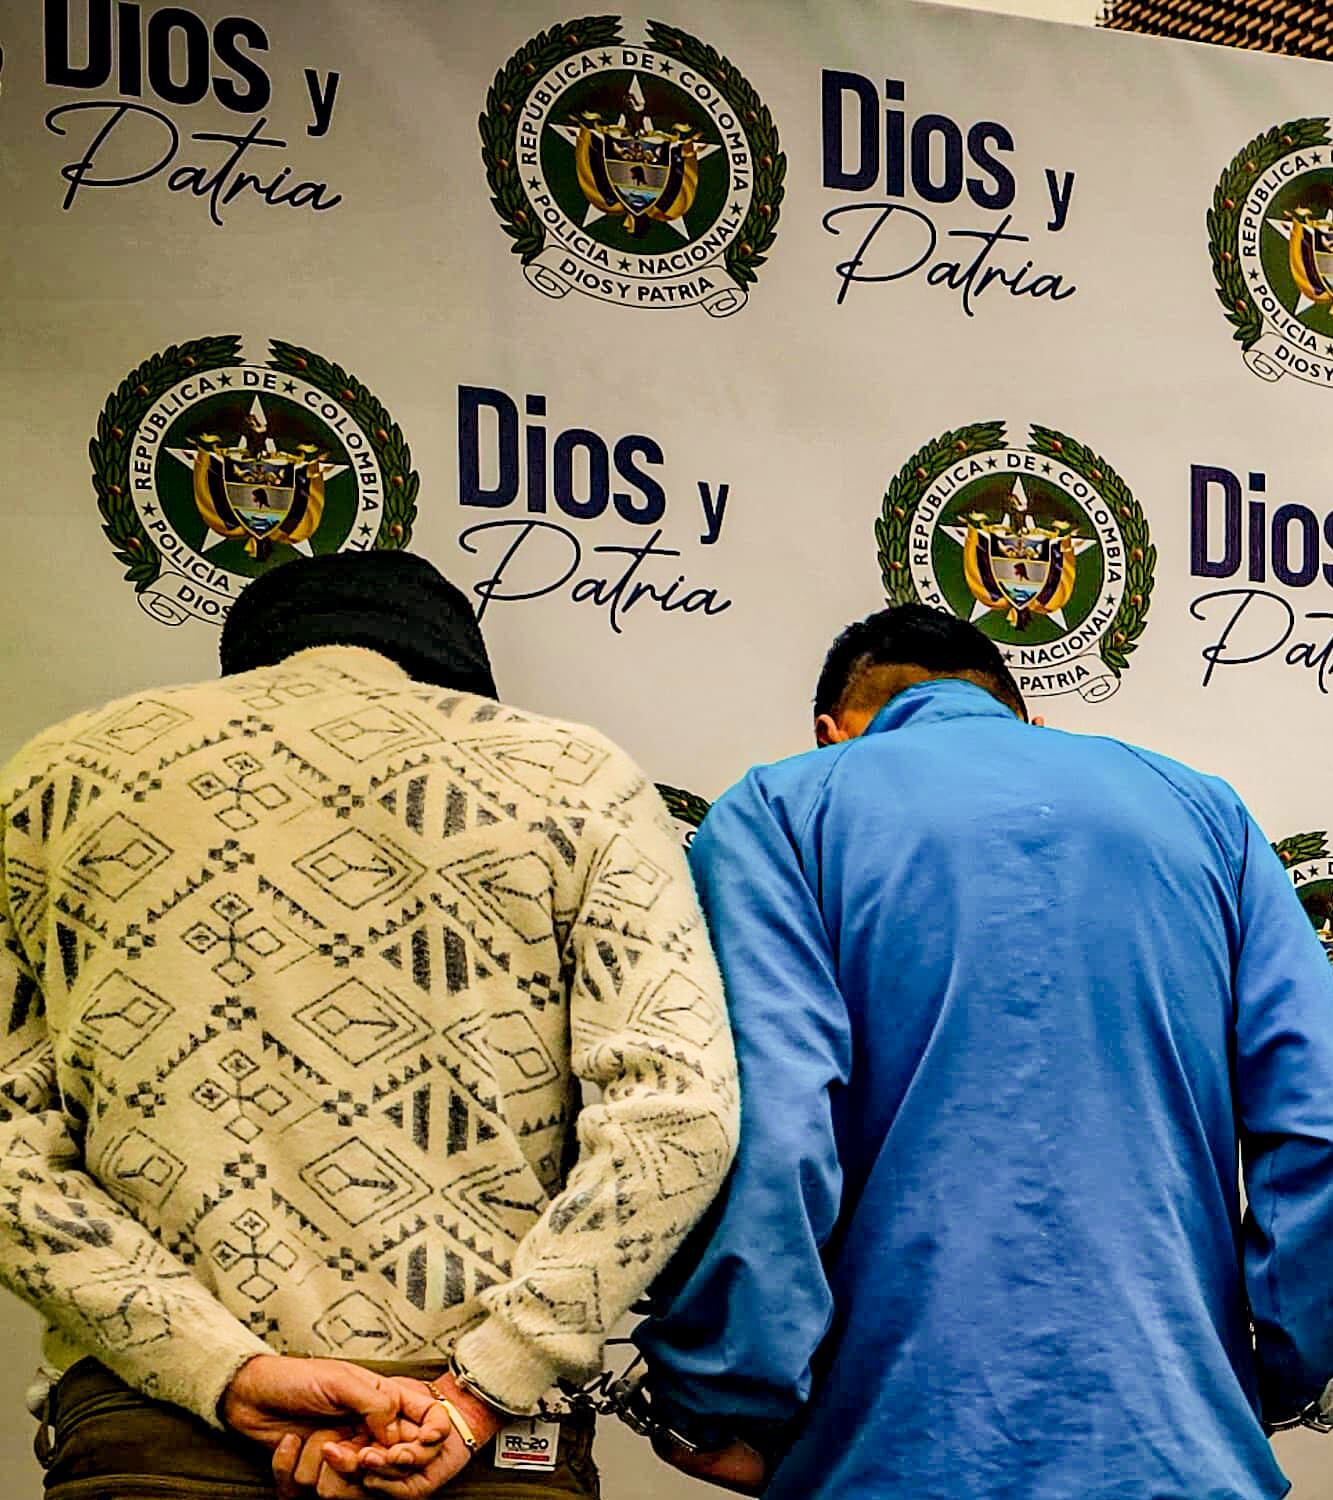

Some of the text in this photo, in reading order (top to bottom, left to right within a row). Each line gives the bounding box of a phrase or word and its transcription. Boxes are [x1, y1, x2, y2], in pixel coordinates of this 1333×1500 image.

[45, 0, 339, 136] Dios y
[622, 51, 655, 70] DE
[679, 71, 749, 192] COLOMBIA
[45, 102, 341, 225] Patria
[822, 69, 1074, 231] Dios y
[638, 219, 739, 274] NACIONAL
[638, 277, 714, 302] PATRIA
[823, 203, 1076, 317] Patria
[242, 371, 278, 390] DE
[303, 391, 379, 512] COLOMBIA
[458, 385, 729, 544] Dios y
[459, 521, 731, 633] Patria
[1006, 454, 1037, 471] DE
[1058, 471, 1122, 584] COLOMBIA
[1020, 609, 1113, 665] NACIONAL
[1020, 665, 1090, 691] PATRIA
